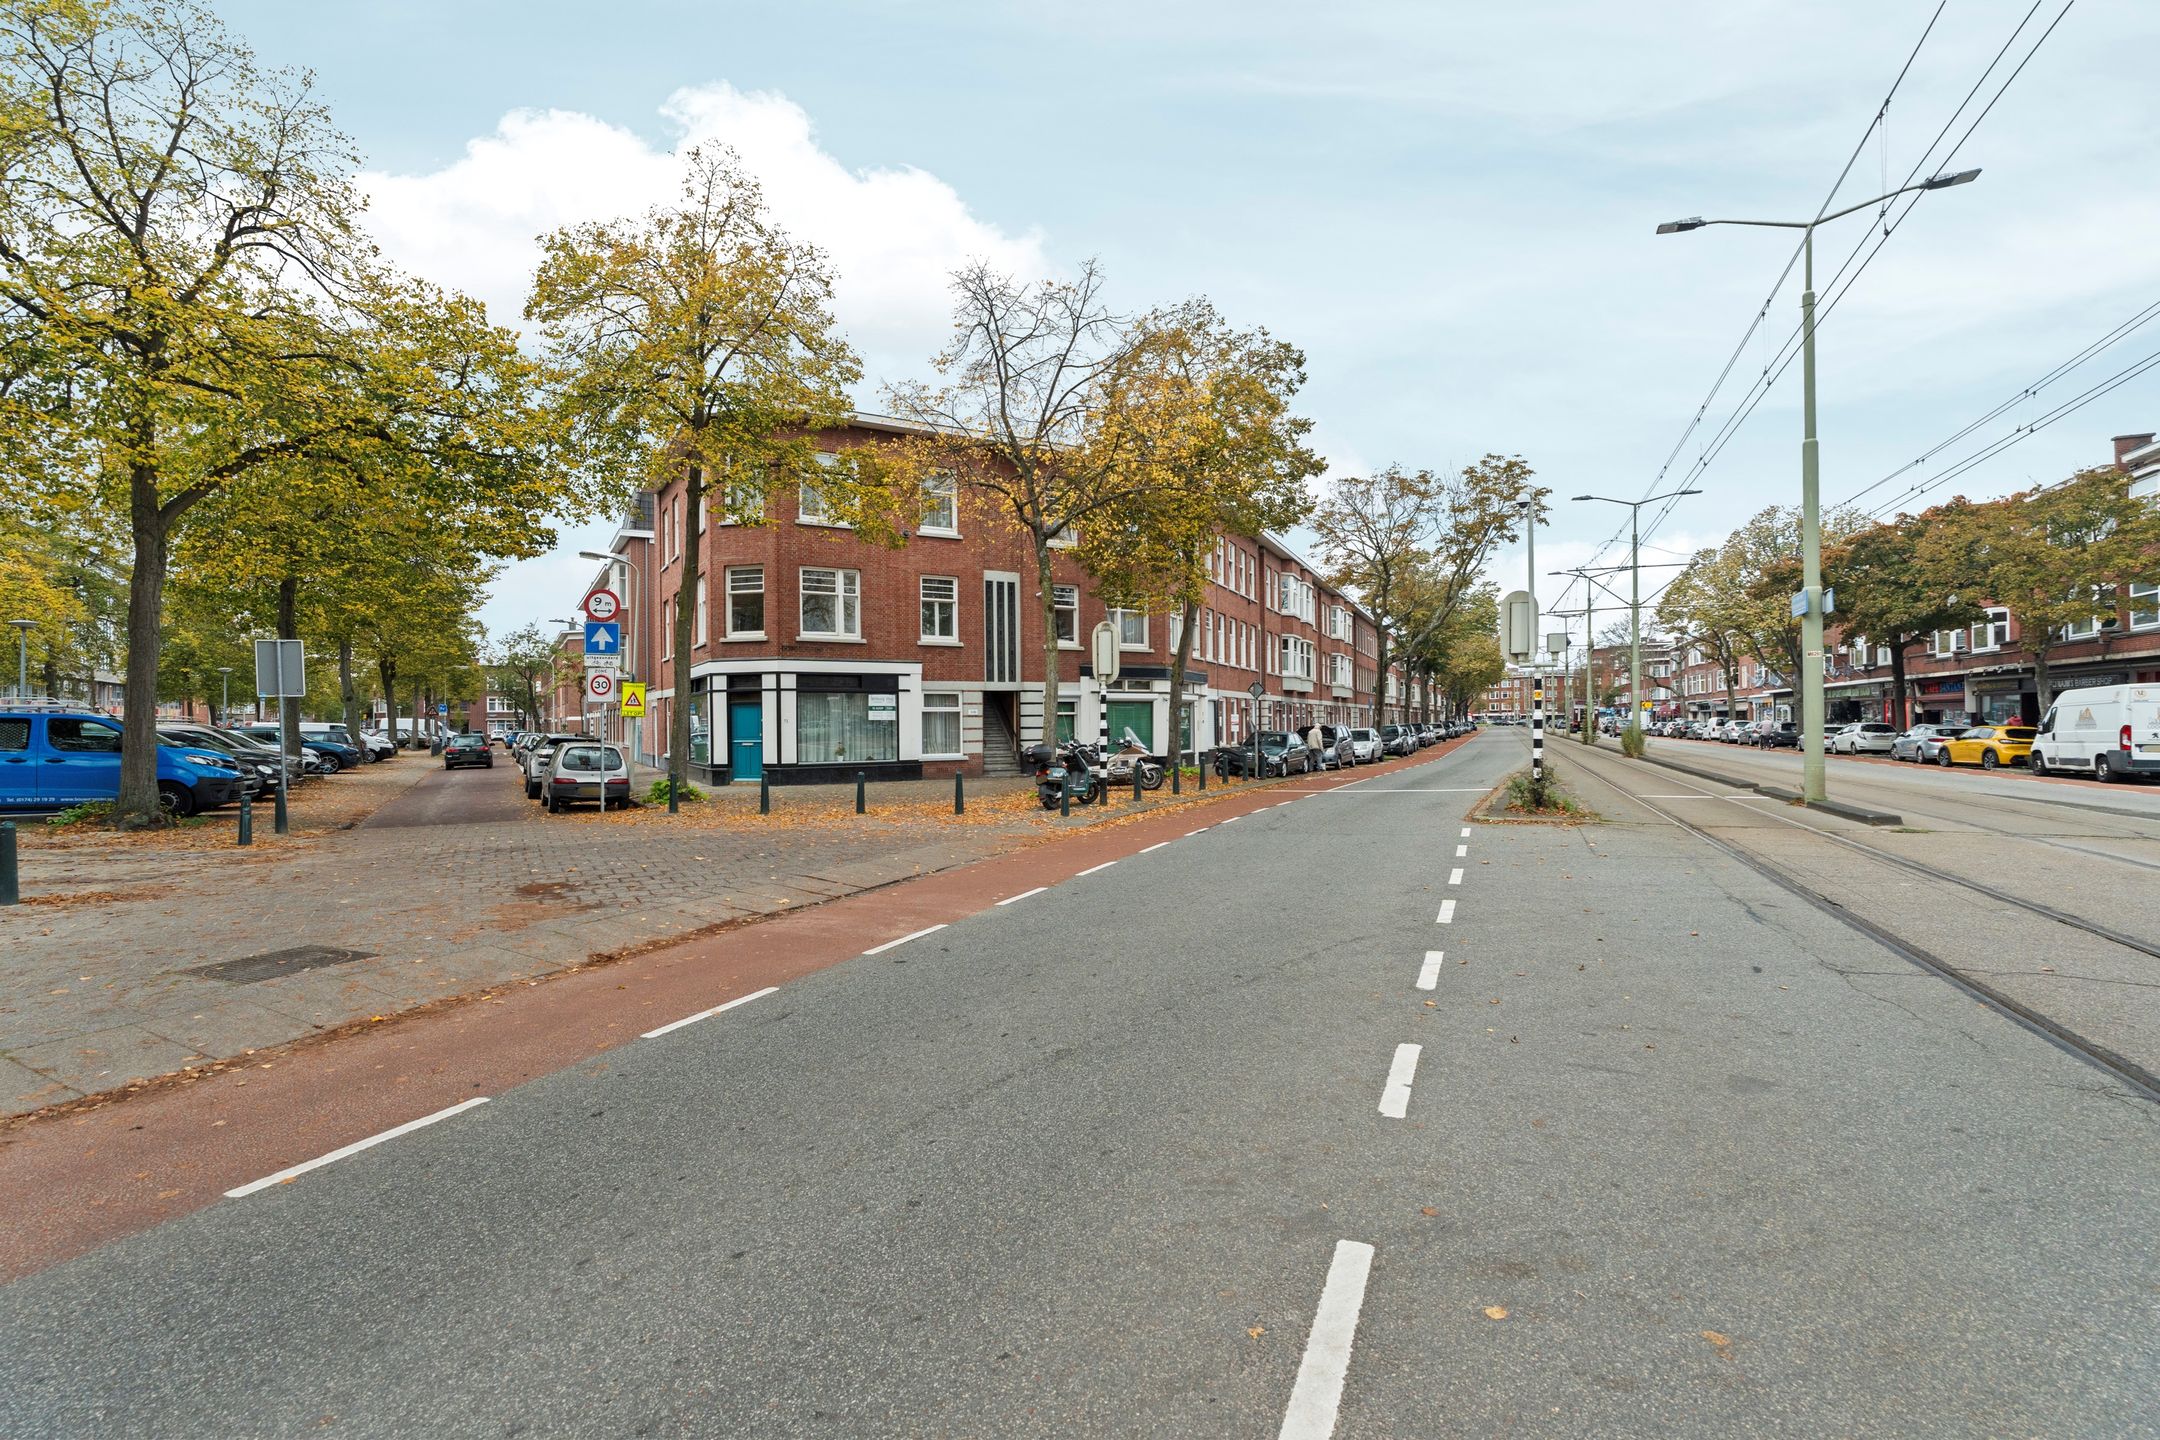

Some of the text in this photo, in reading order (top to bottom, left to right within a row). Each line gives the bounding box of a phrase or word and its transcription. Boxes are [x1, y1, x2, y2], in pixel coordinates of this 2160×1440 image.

[594, 597, 602, 606] 9
[594, 681, 608, 689] 30
[2097, 676, 2112, 685] SHOP
